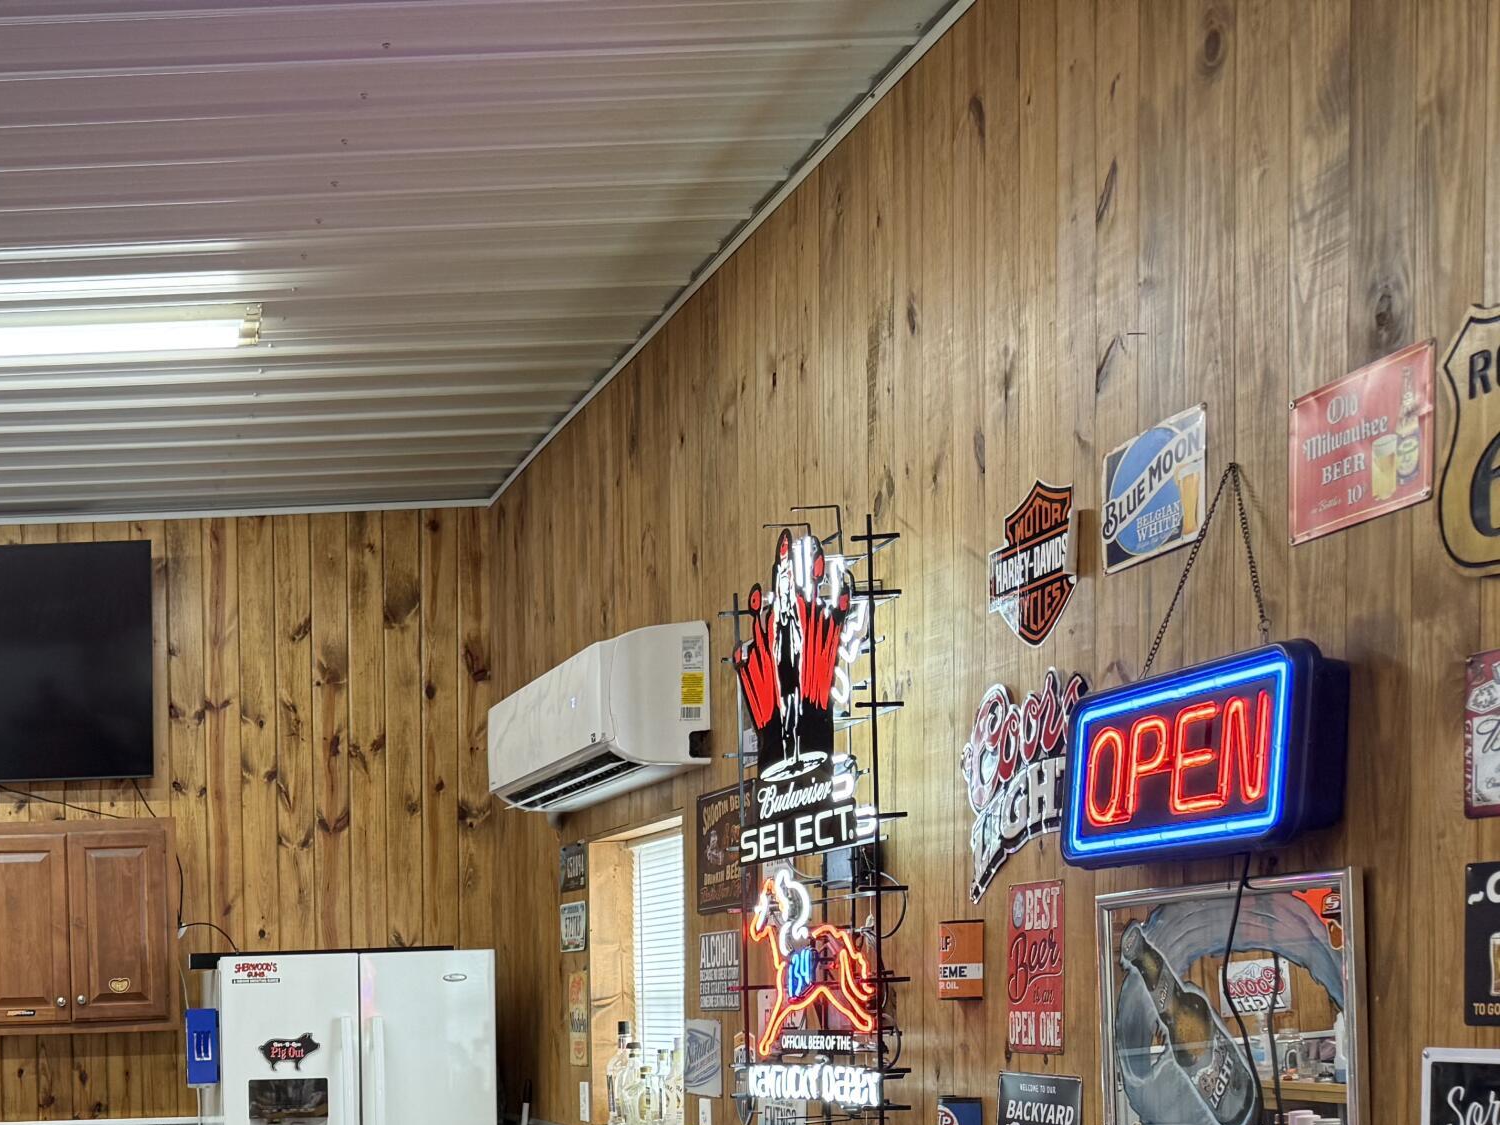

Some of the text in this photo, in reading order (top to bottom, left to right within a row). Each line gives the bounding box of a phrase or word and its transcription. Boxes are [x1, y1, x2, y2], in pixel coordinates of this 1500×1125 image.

[1327, 393, 1359, 425] Old
[1303, 415, 1389, 462] Milwaukee
[1103, 426, 1201, 540] BLUE MOON
[1321, 451, 1366, 486] BEER
[1014, 497, 1061, 543] MOTOR
[1136, 501, 1181, 528] BELGIAN
[1136, 513, 1182, 543] WHITE
[1019, 580, 1062, 631] YCLES
[1085, 689, 1271, 827] OPEN
[757, 777, 832, 820] Budweiser
[973, 756, 1066, 876] LIGH
[1025, 887, 1060, 931] BEST
[700, 931, 739, 968] ALCOHOL
[1008, 931, 1061, 1004] Beer
[1473, 1003, 1486, 1016] TO
[781, 1035, 851, 1050] OFFICIAL BEER OF THE
[1009, 1011, 1061, 1047] OPEN ONE
[270, 1046, 304, 1060] Pig Out
[1020, 1083, 1039, 1092] WELCOME
[1047, 1086, 1056, 1094] OUR
[1209, 1051, 1234, 1109] LIGHT
[1006, 1100, 1074, 1125] BACKYARD
